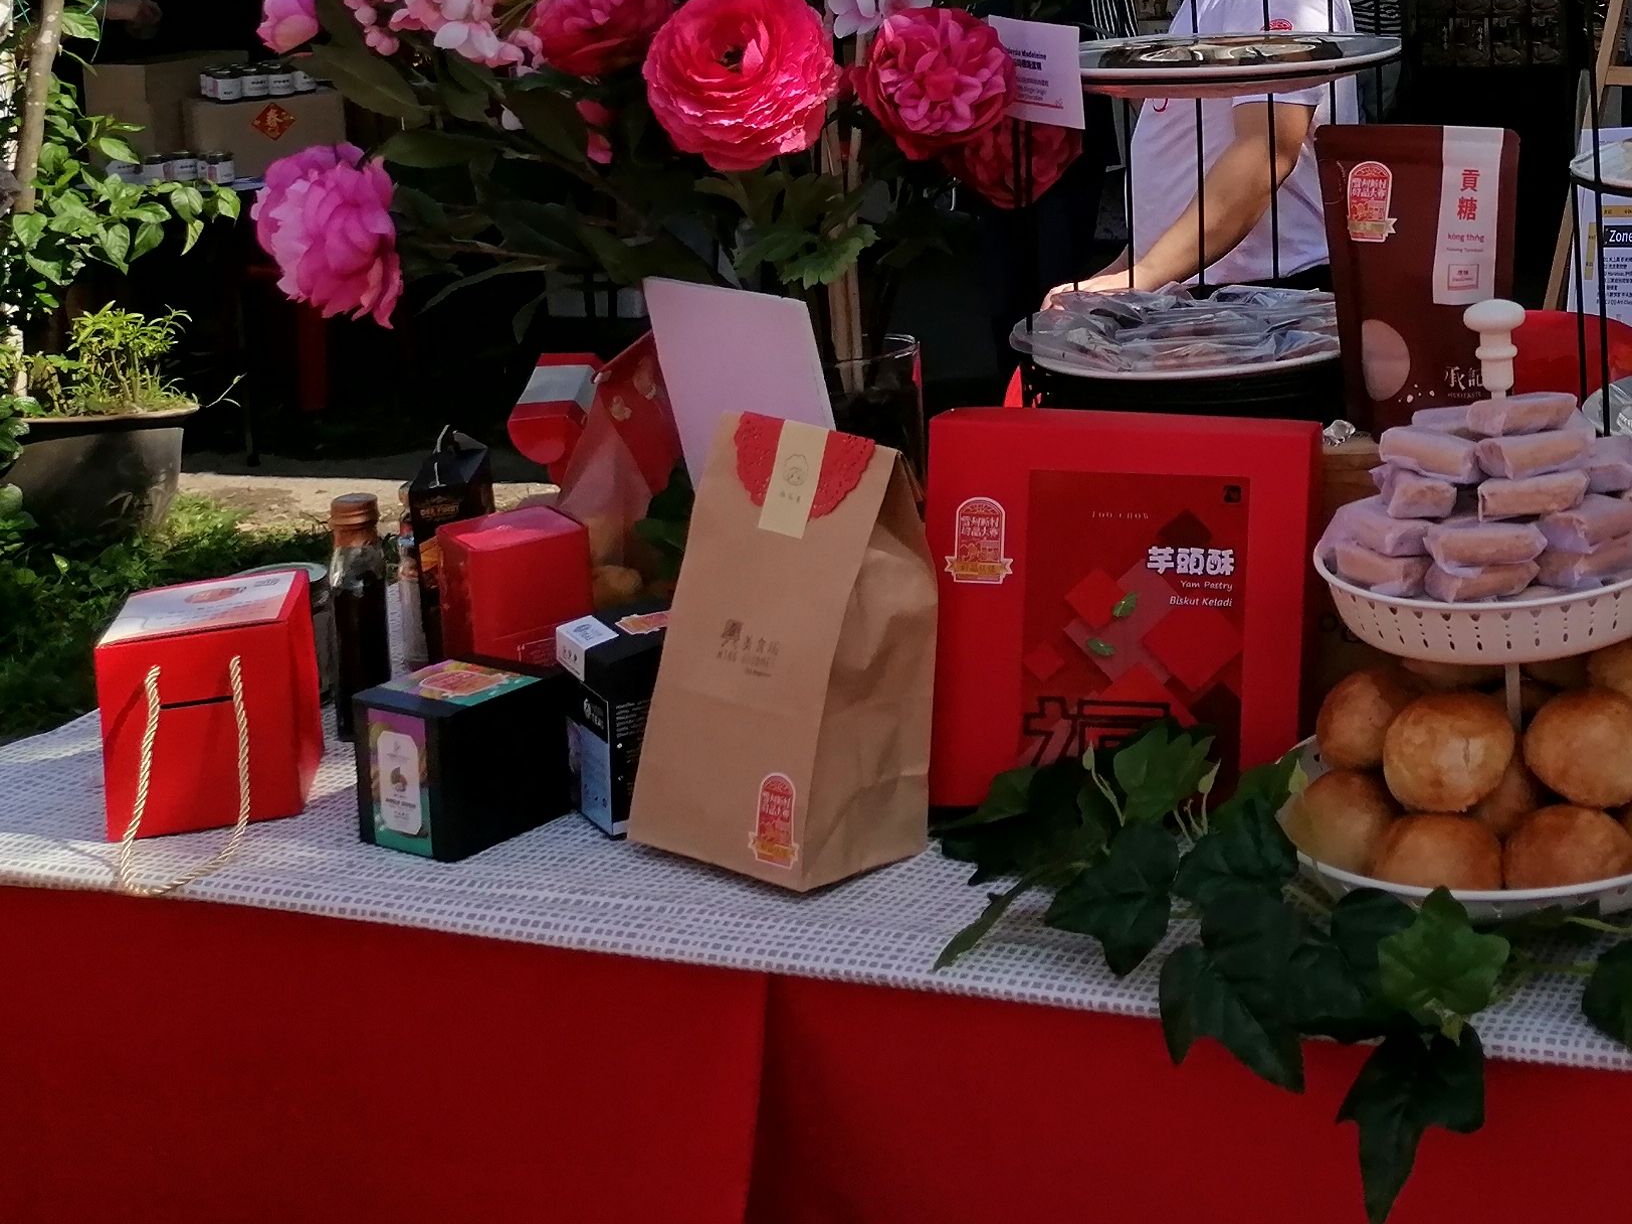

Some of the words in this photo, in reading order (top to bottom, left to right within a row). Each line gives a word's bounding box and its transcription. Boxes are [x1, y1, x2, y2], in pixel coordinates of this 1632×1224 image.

[1456, 168, 1481, 221] 貢糖
[1146, 545, 1235, 576] 芋頭酥
[1180, 580, 1200, 589] Yam
[1204, 581, 1233, 592] Pastry
[1169, 595, 1200, 606] Biskut
[1202, 597, 1233, 608] Keladi
